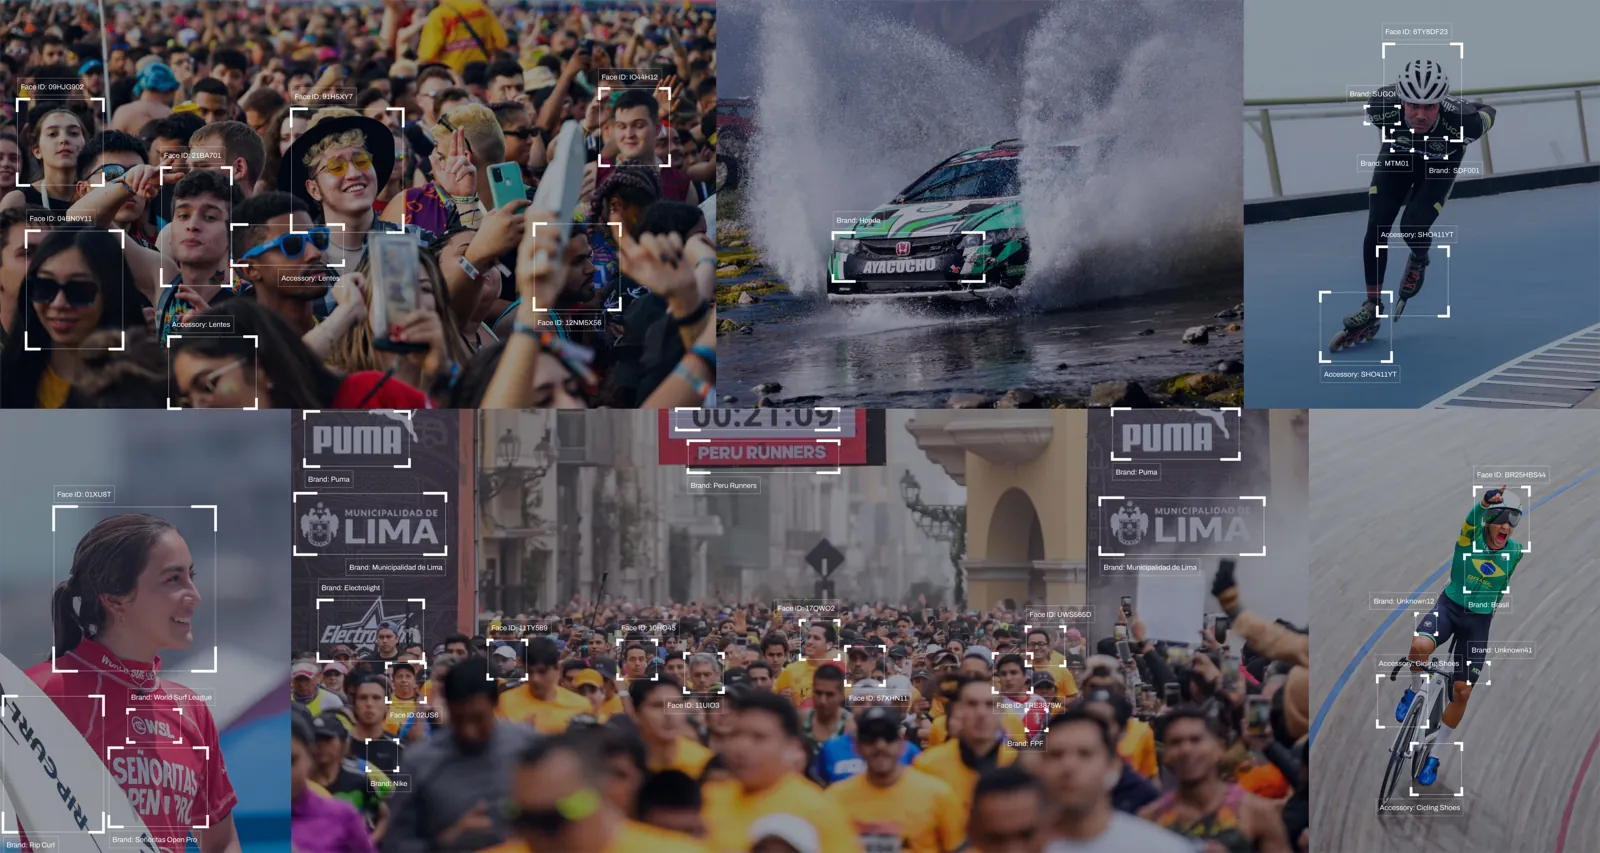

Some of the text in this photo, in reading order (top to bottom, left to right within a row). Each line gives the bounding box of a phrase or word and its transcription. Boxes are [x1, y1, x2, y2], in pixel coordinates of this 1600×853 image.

[863, 258, 936, 274] AYACUCHO
[692, 409, 834, 428] 00:21:09
[313, 426, 401, 454] PUMA
[1122, 423, 1212, 452] PUMA
[697, 445, 827, 460] PERU RUNNERS
[345, 509, 438, 517] MUNICIPALIDAD DE
[1154, 506, 1250, 515] MUNICIPALIDAD DE
[345, 518, 439, 544] LIMA
[1155, 516, 1251, 543] LIMA
[145, 718, 175, 739] WSL
[113, 749, 198, 796] SEÑORITAS
[127, 788, 160, 816] PEN
